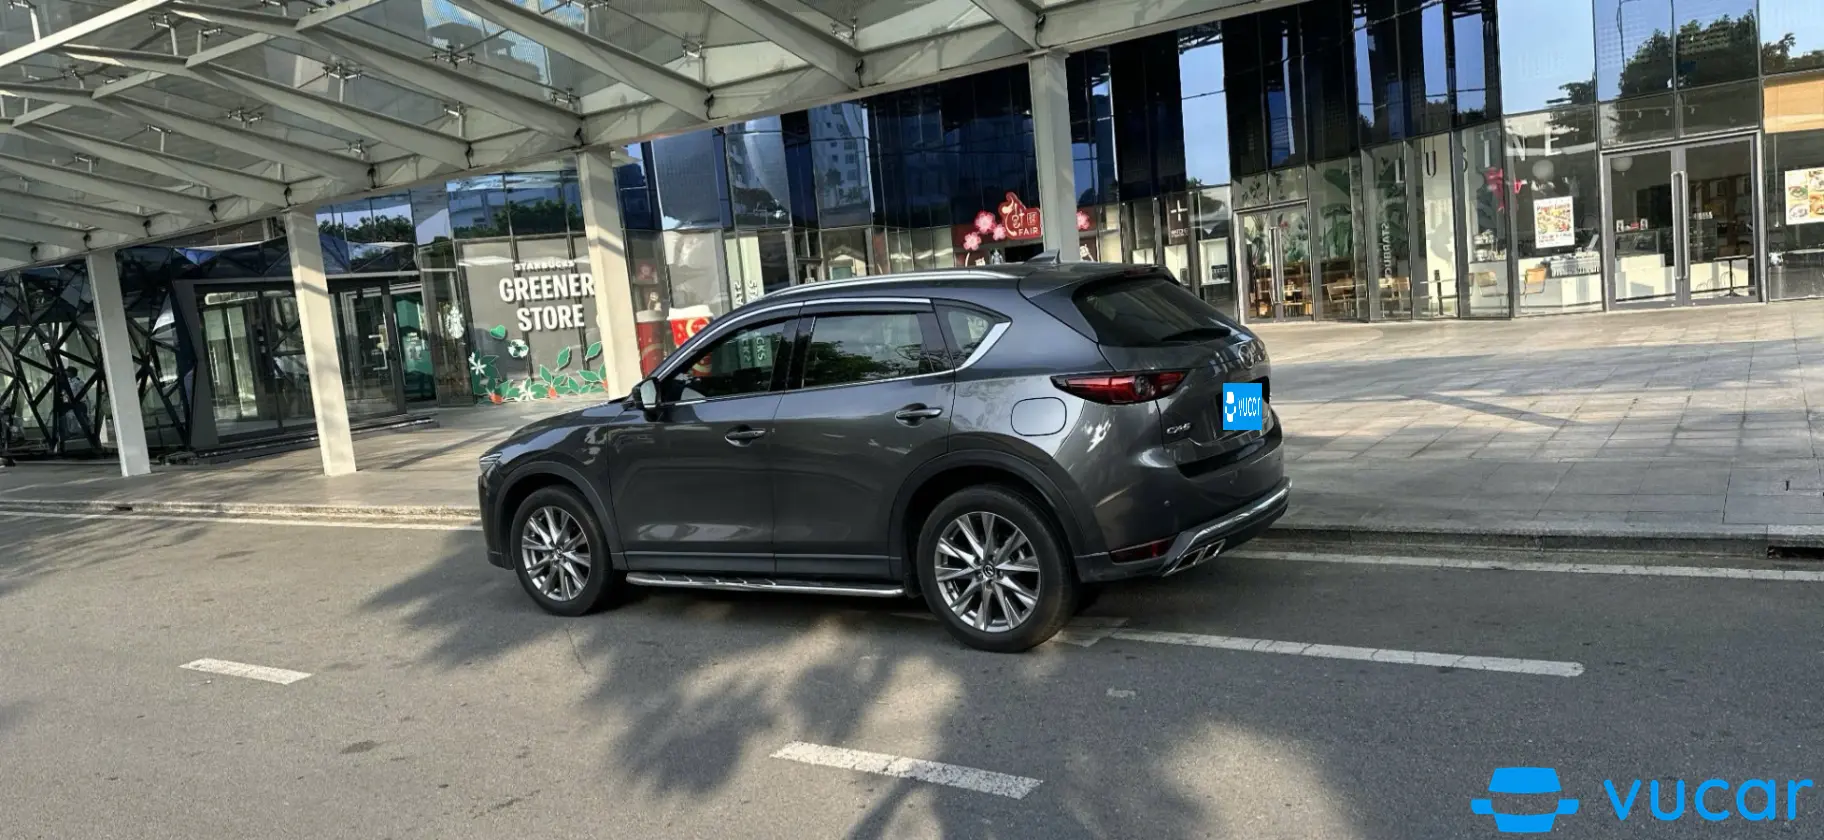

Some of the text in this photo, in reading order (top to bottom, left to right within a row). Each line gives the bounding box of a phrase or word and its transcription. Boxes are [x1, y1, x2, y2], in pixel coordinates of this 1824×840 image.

[1018, 226, 1038, 236] FAIR
[514, 260, 575, 271] STARBUCKS
[499, 273, 595, 302] GREENER
[516, 304, 585, 331] STORE
